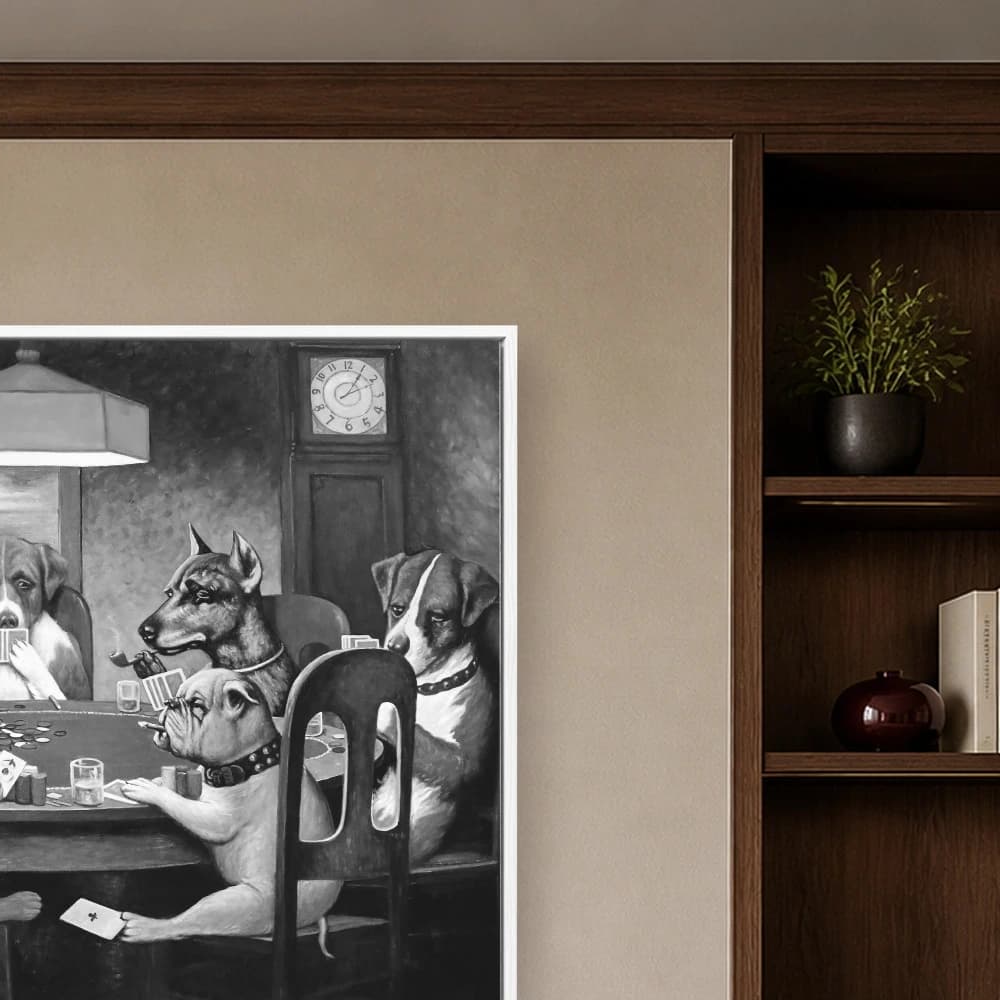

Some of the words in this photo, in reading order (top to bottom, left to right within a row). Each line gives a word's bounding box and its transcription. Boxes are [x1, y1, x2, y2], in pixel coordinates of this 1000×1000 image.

[327, 363, 337, 372] 11
[343, 361, 353, 370] 12
[360, 364, 366, 372] 1
[315, 373, 326, 382] 10
[369, 374, 378, 383] 2
[313, 403, 325, 412] 8
[373, 405, 384, 414] 4
[325, 414, 335, 425] 7
[362, 417, 371, 427] 5
[344, 419, 353, 431] 6
